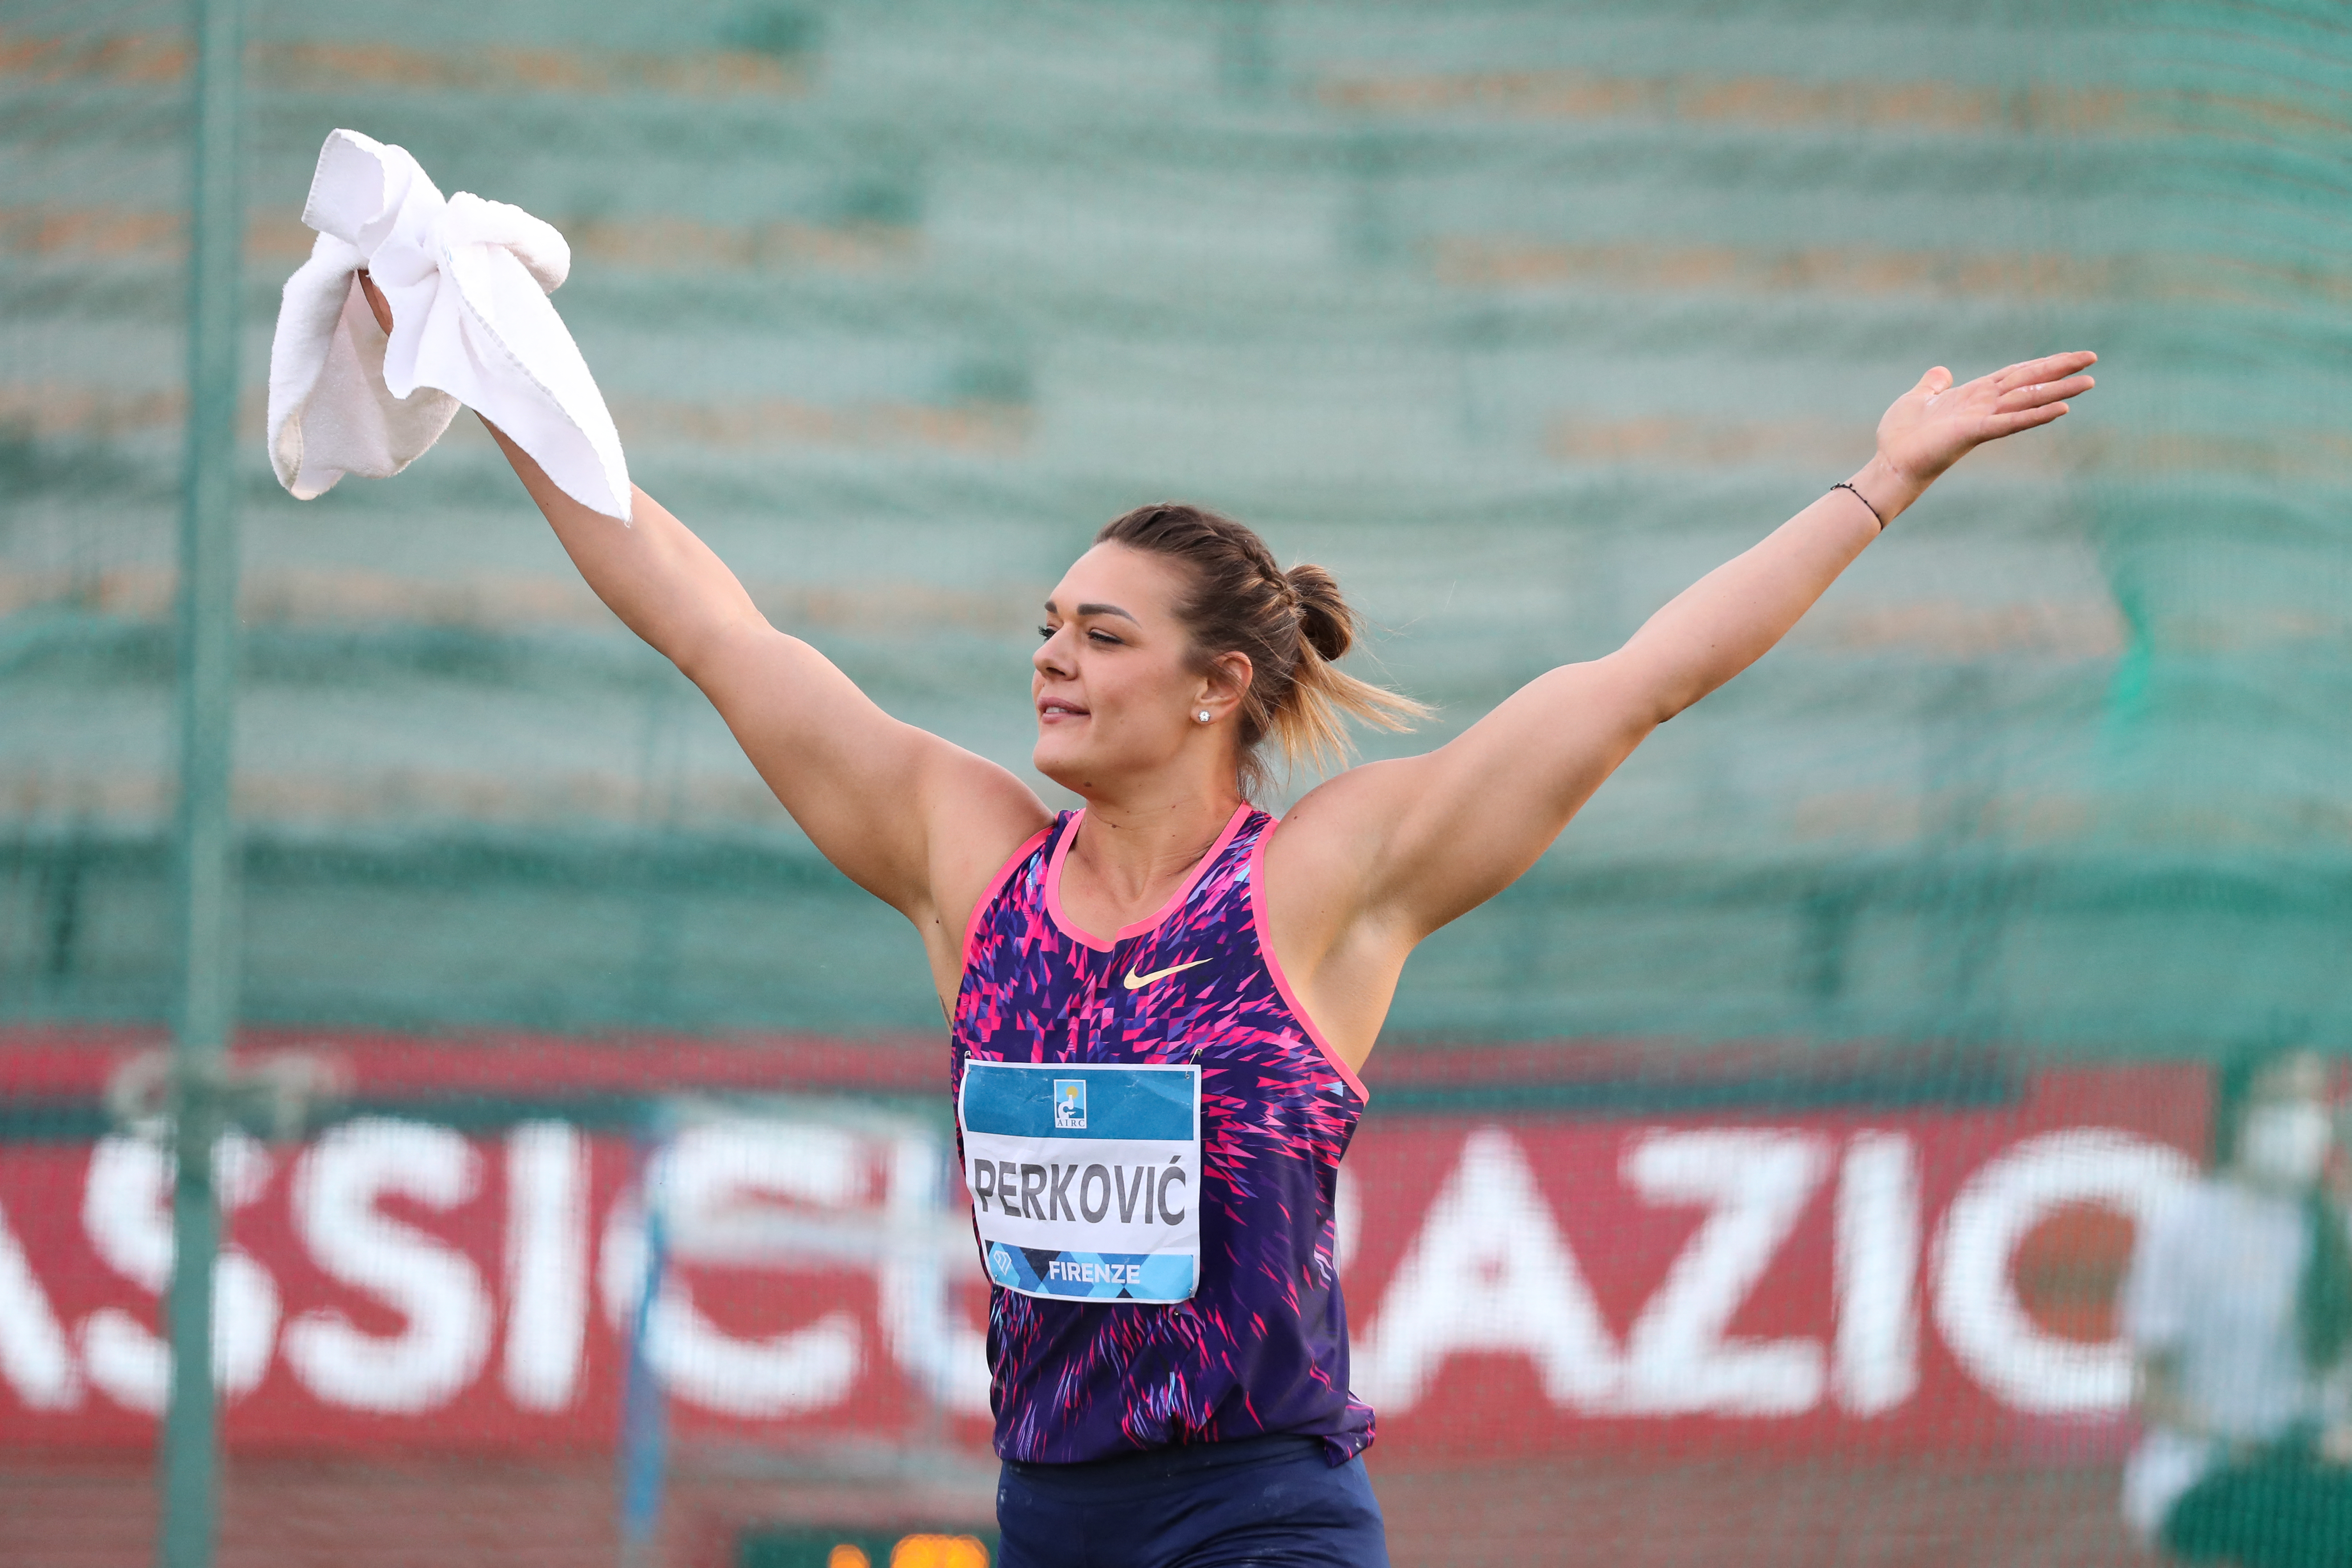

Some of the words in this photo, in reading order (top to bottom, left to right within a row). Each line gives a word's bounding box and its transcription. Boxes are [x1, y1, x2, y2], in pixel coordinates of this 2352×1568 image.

[1057, 1119, 1085, 1127] AIRC
[974, 1155, 1186, 1226] PERKOVIĆ
[1048, 1260, 1140, 1284] FIRENZE
